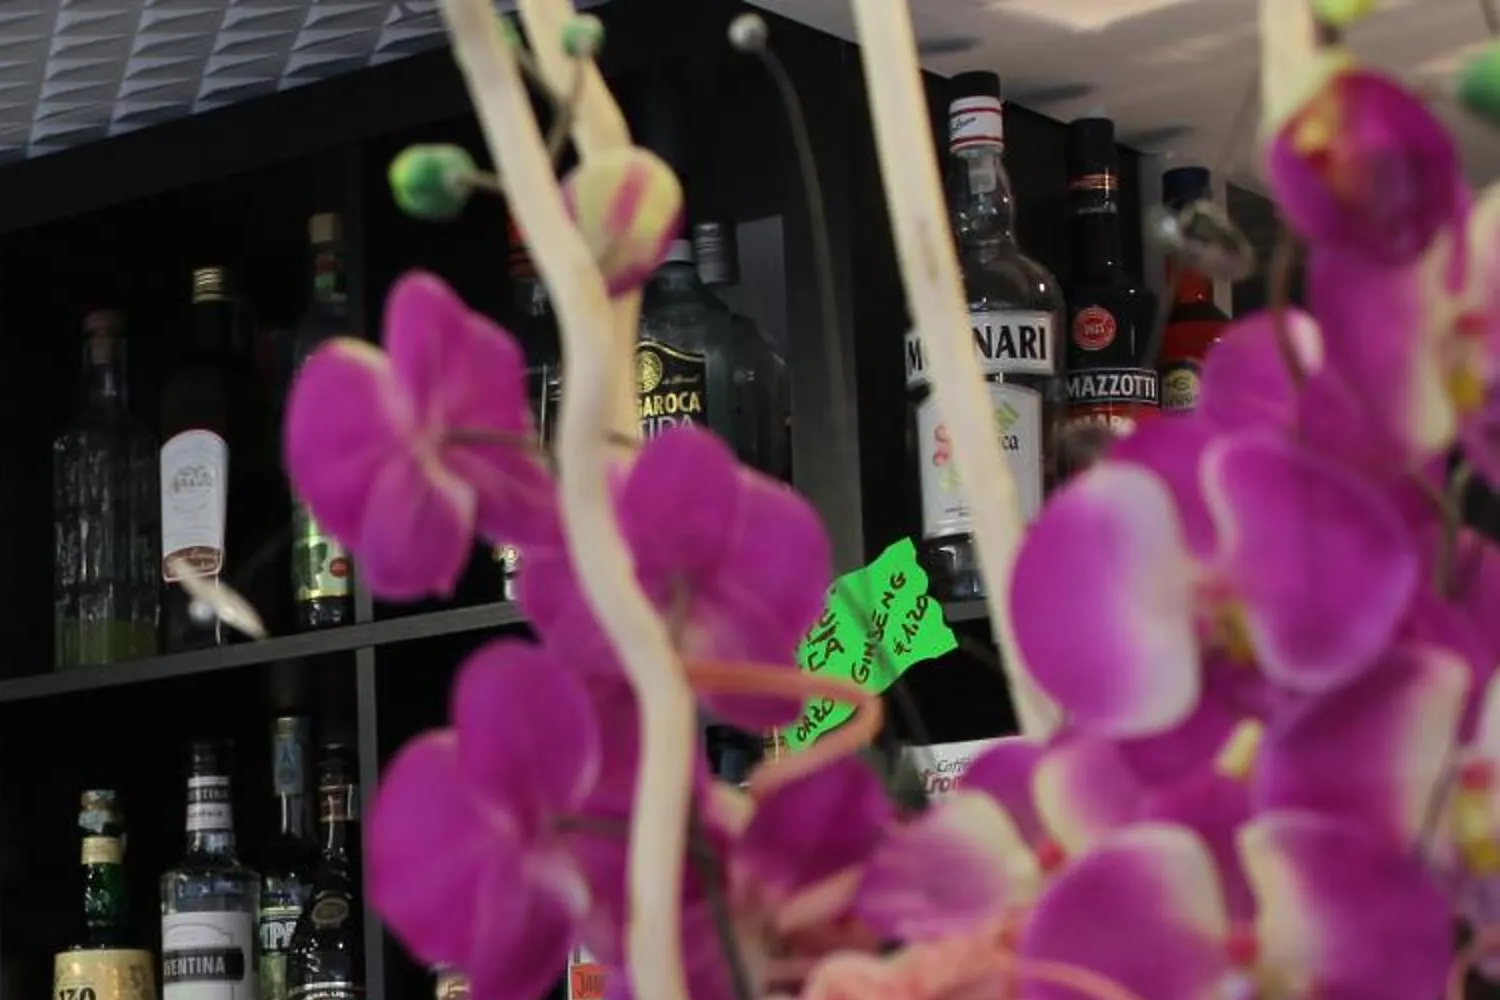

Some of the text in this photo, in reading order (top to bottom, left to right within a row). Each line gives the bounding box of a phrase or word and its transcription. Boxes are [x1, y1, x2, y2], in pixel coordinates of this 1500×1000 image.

[907, 325, 1047, 376] MNARI
[1066, 373, 1156, 399] MAZZOTTI
[851, 571, 906, 685] GINSENG
